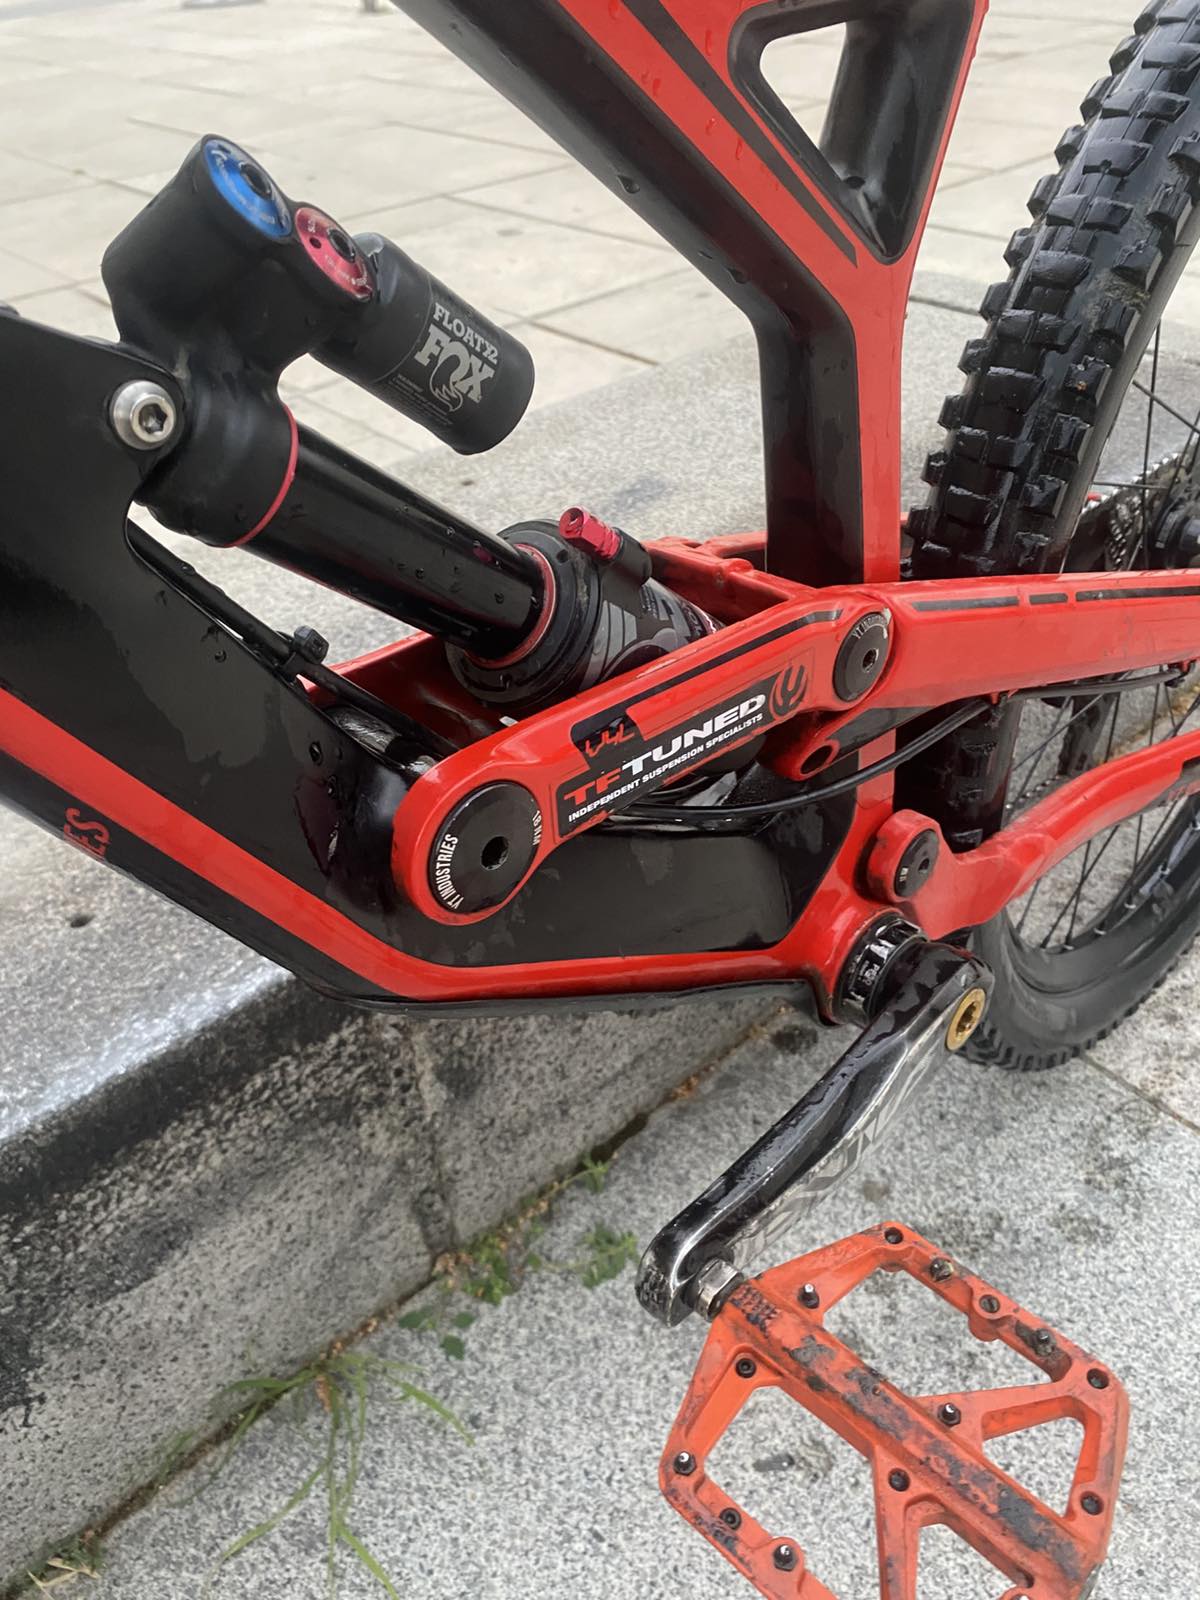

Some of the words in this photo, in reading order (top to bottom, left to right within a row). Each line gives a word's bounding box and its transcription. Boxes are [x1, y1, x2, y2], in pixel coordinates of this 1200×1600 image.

[414, 323, 496, 412] FOX
[568, 778, 641, 823] INDEPENDENT
[642, 744, 705, 783] SUSPENSION
[705, 712, 764, 749] SPECIALISTS
[435, 833, 459, 901] INDUSTRIES
[447, 894, 465, 910] YT
